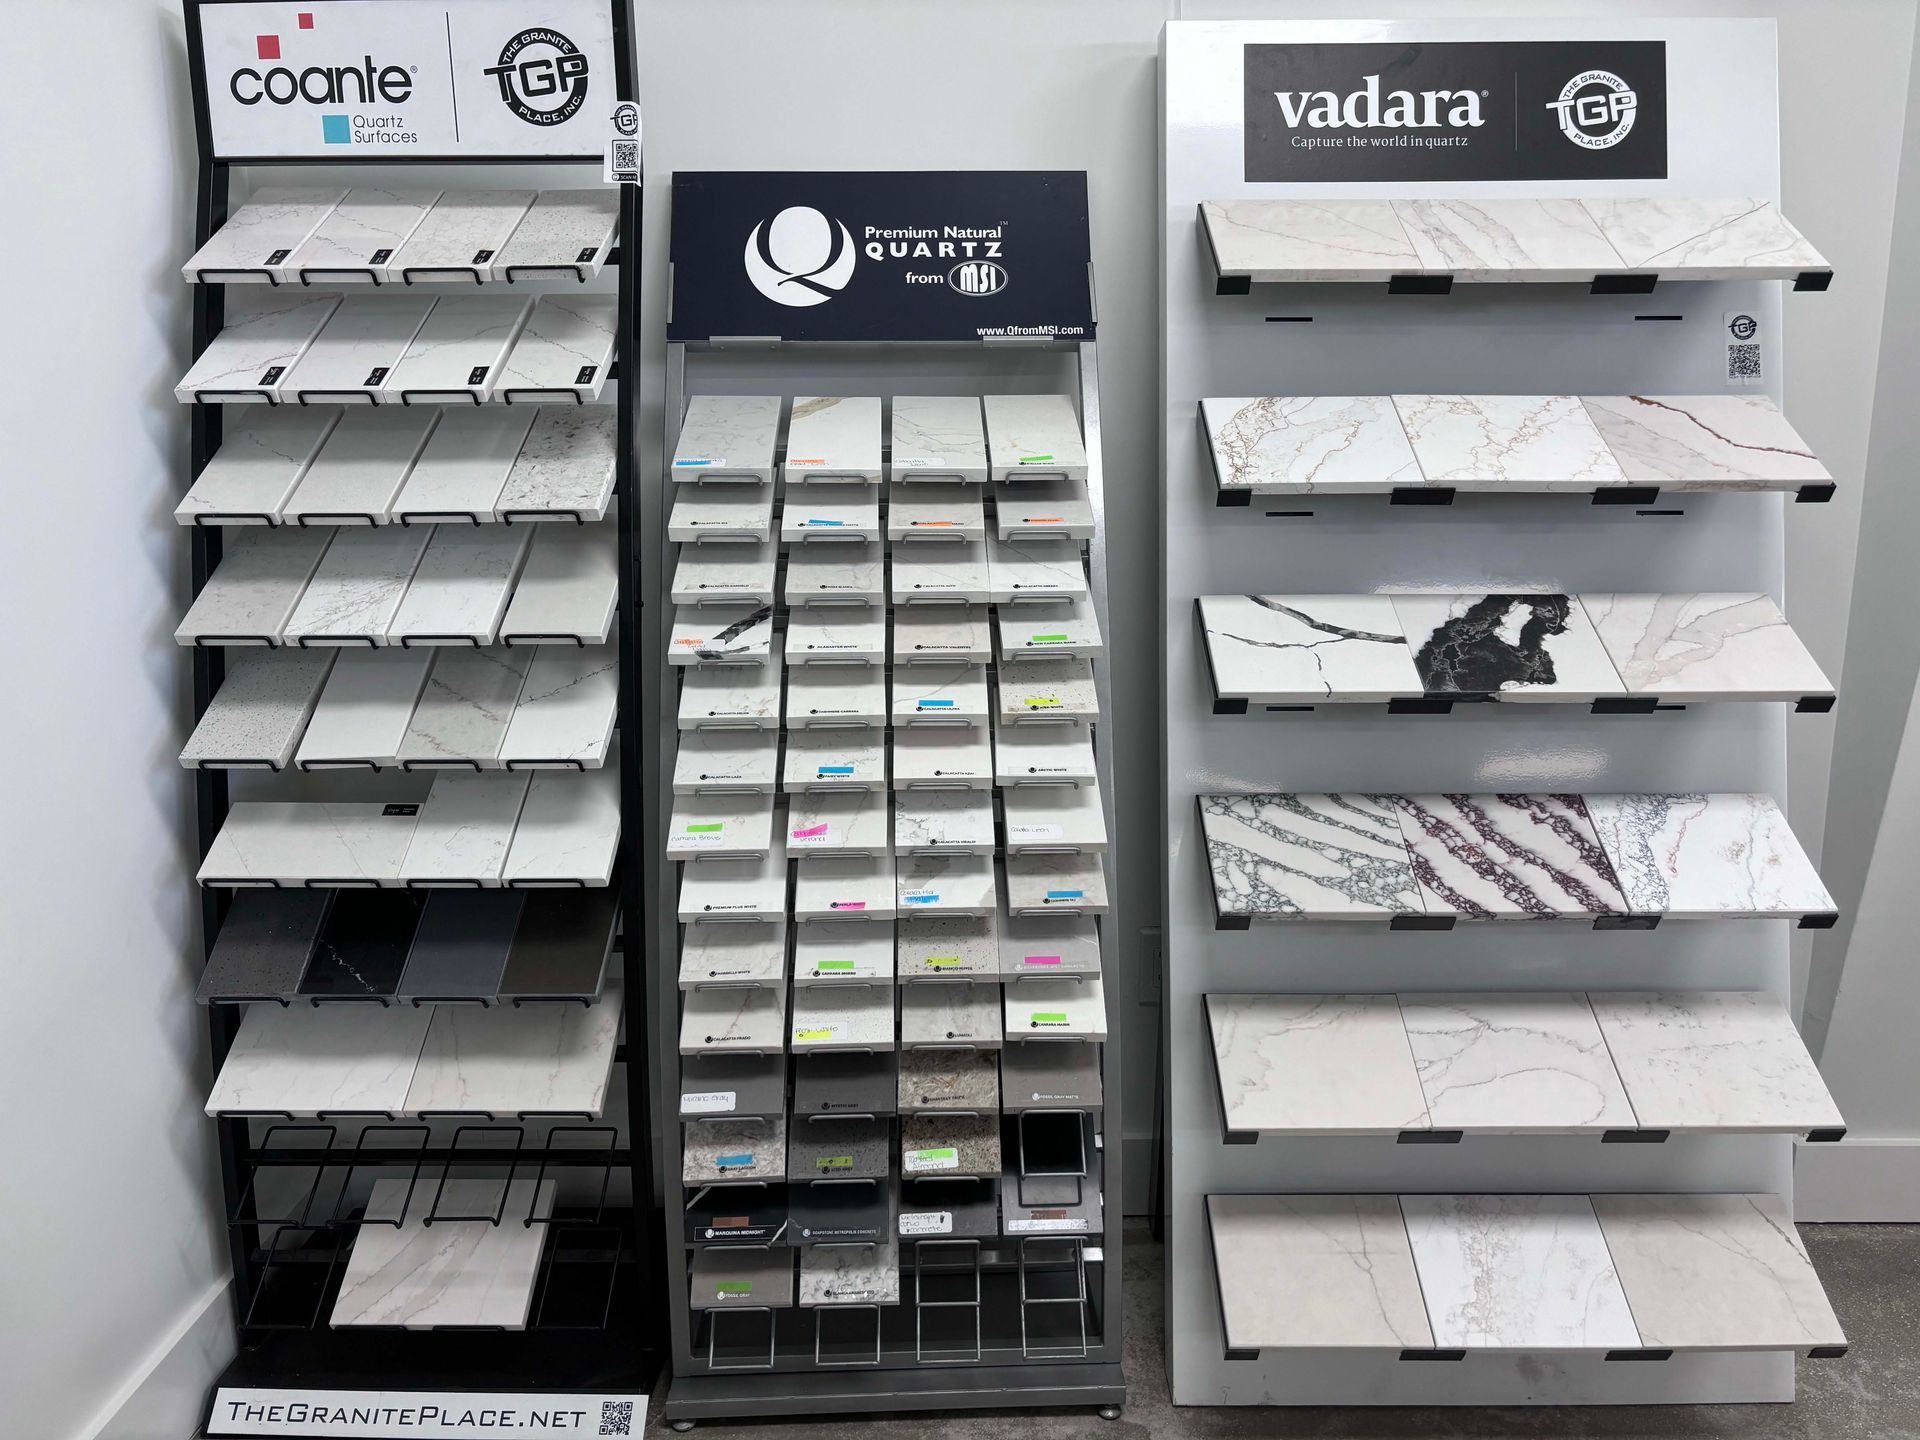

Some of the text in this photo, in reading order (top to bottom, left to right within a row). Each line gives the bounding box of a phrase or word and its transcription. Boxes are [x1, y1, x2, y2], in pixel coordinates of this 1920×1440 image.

[503, 32, 572, 63] THE GRANITE
[483, 54, 589, 102] TGP
[1563, 73, 1623, 98] THE GRANITE
[518, 95, 582, 123] PLACE, INC.
[1545, 90, 1638, 131] TGP
[353, 115, 404, 128] Quartz
[354, 130, 418, 144] Surfaces
[1291, 135, 1469, 149] Capture the world in quartz
[1573, 123, 1630, 147] PLACE, INC.
[865, 226, 938, 239] Premium
[865, 241, 1002, 261] QUARTZ
[905, 263, 997, 293] from MSI
[976, 325, 1084, 336] www.QfromMSI.com
